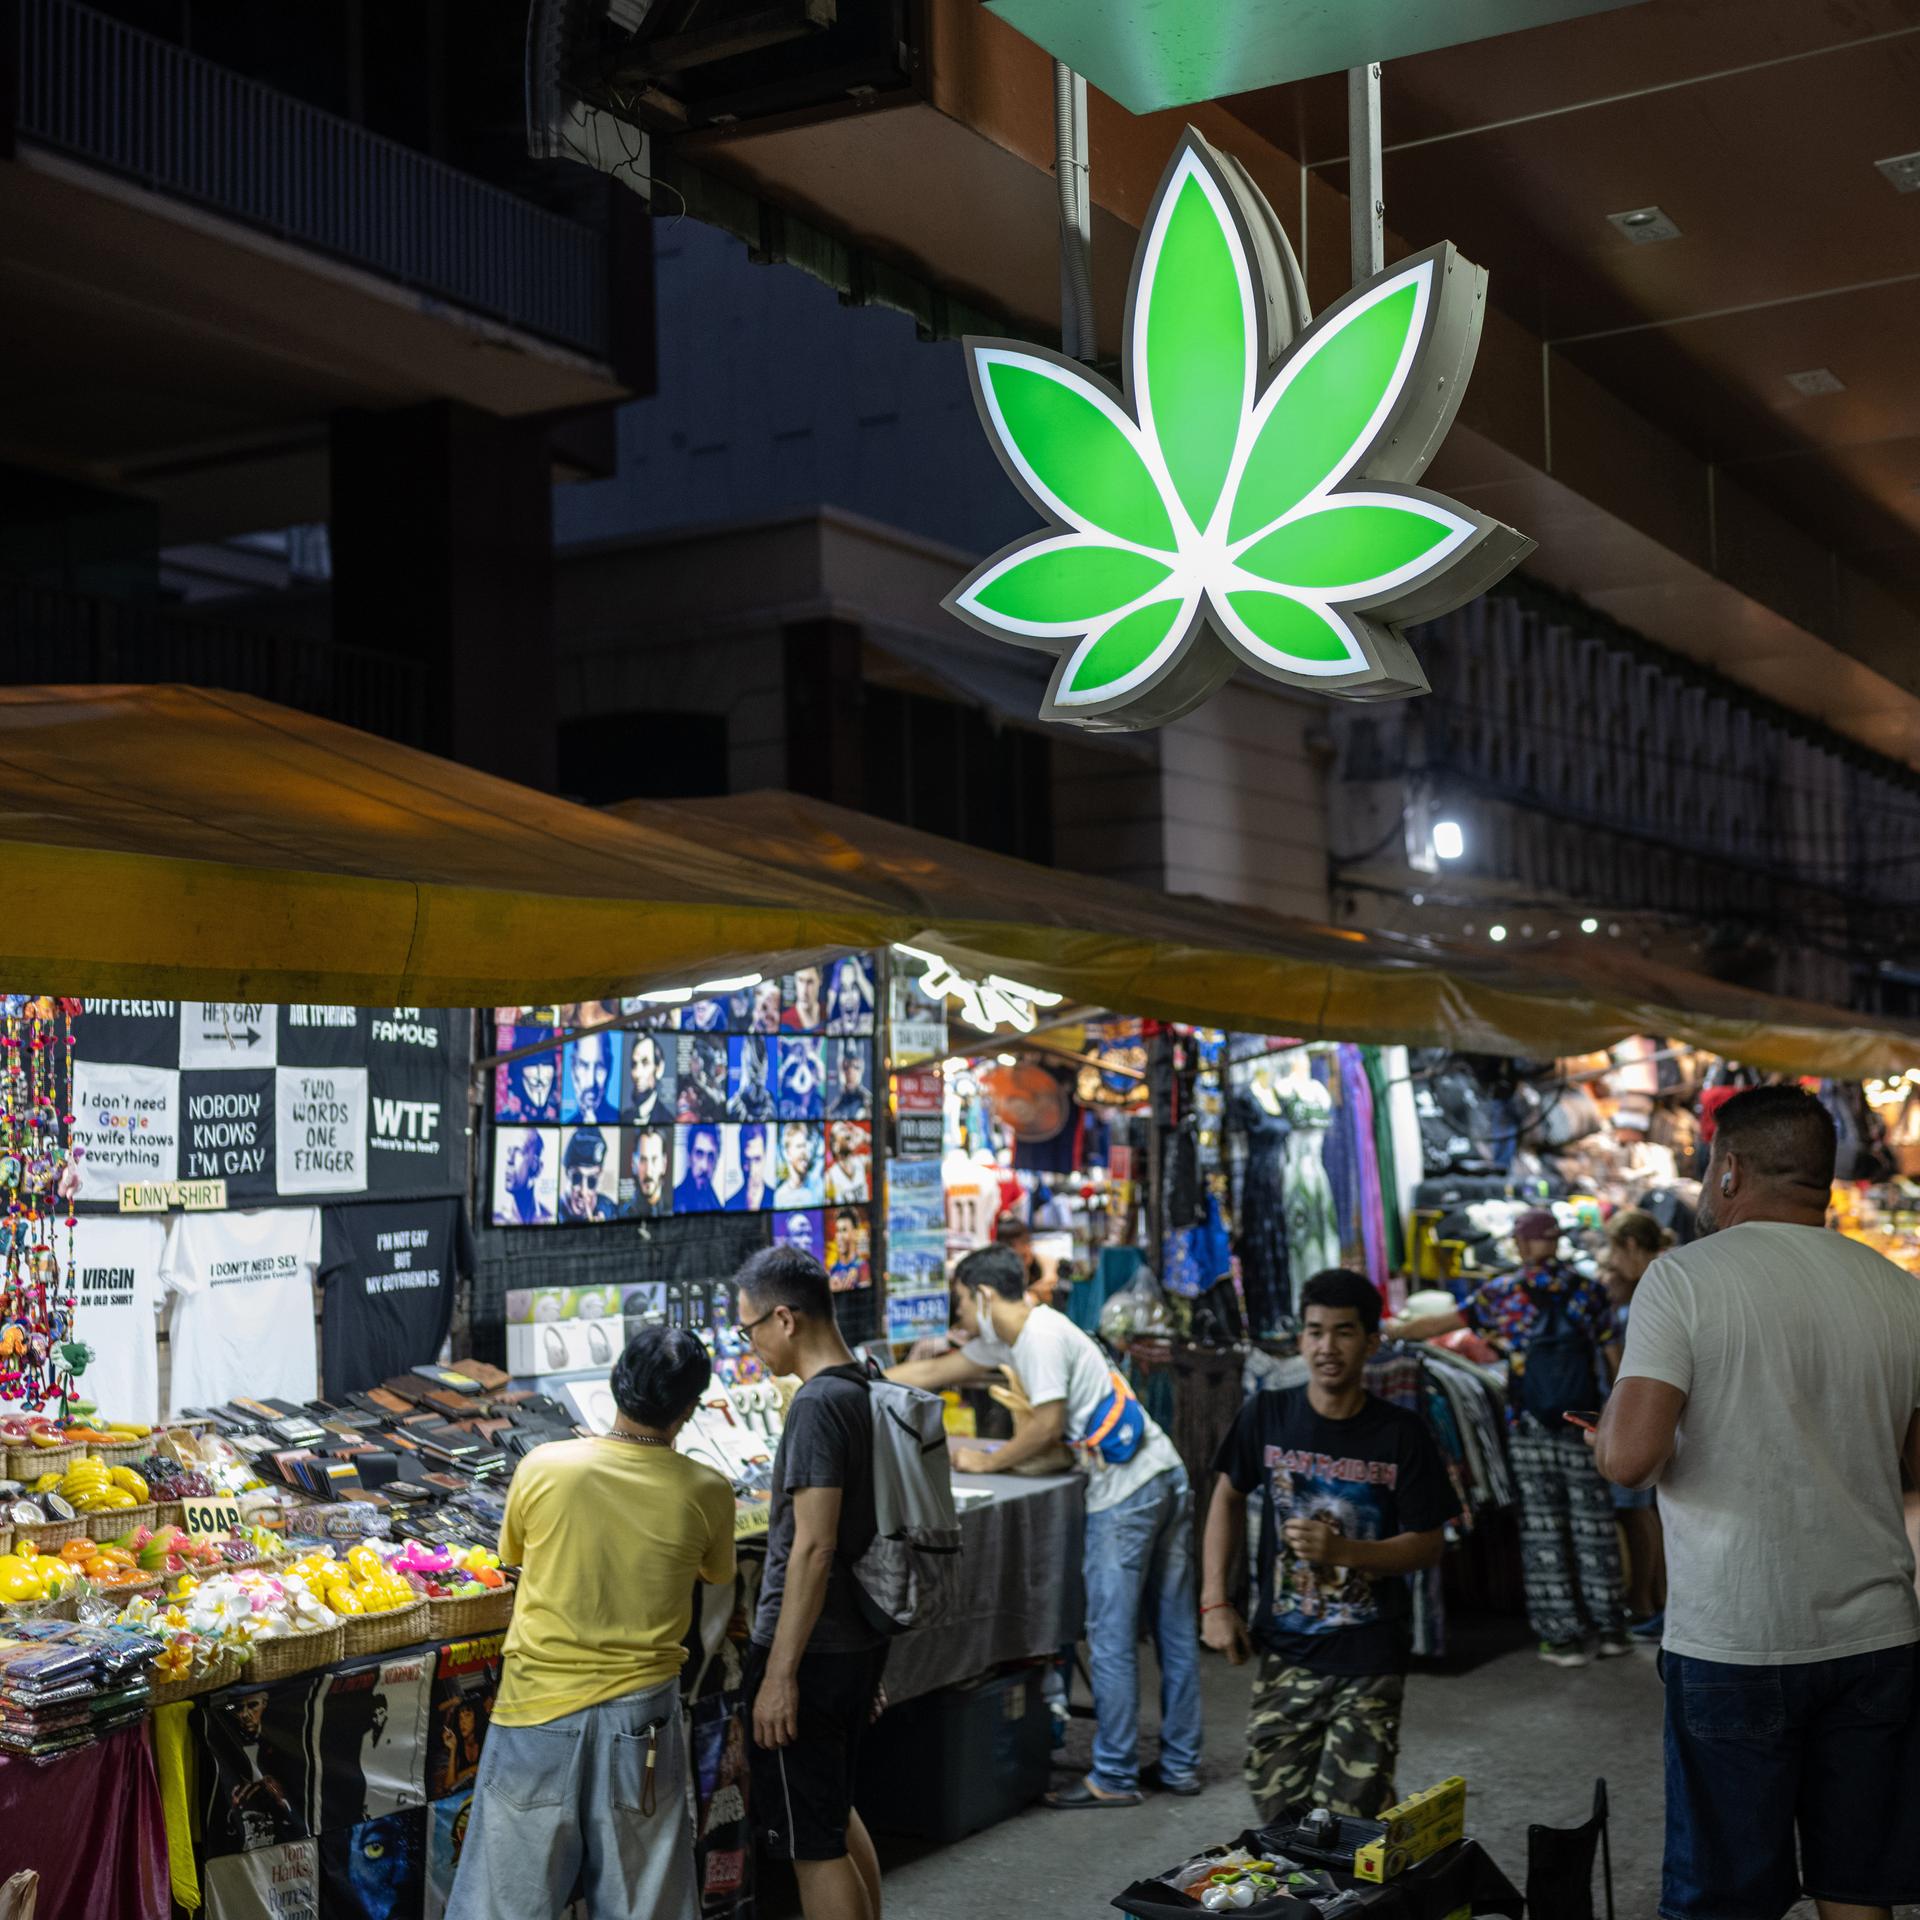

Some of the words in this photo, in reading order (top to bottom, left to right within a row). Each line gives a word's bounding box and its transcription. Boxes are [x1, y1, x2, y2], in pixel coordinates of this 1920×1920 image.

[84, 998, 175, 1018] DIFFERENT
[233, 1003, 263, 1024] GAY
[372, 1020, 438, 1048] FAMOUS
[301, 1079, 335, 1100] TWO
[82, 1091, 87, 1107] I
[92, 1093, 130, 1109] don't
[134, 1096, 166, 1111] need
[189, 1093, 261, 1120] NOBODY
[99, 1111, 149, 1130] Google
[293, 1103, 349, 1125] WORDS
[373, 1097, 440, 1139] WTF
[72, 1131, 94, 1148] my
[98, 1130, 125, 1146] wife
[129, 1131, 174, 1147] knows
[194, 1122, 257, 1149] KNOWS
[306, 1126, 337, 1148] ONE
[85, 1148, 160, 1166] everything
[188, 1152, 219, 1177] I'M
[224, 1147, 266, 1175] GAY
[294, 1149, 354, 1173] FINGER
[124, 1185, 174, 1207] FUNNY
[178, 1185, 222, 1206] SHIRT
[210, 1263, 214, 1277] I
[216, 1261, 249, 1276] DON'T
[251, 1257, 275, 1272] NEED
[277, 1254, 298, 1269] SEX
[82, 1267, 135, 1290] VIRGIN
[80, 1295, 92, 1306] AN
[94, 1295, 108, 1306] OLD
[110, 1294, 134, 1306] SHIRT
[188, 1506, 240, 1533] SOAP
